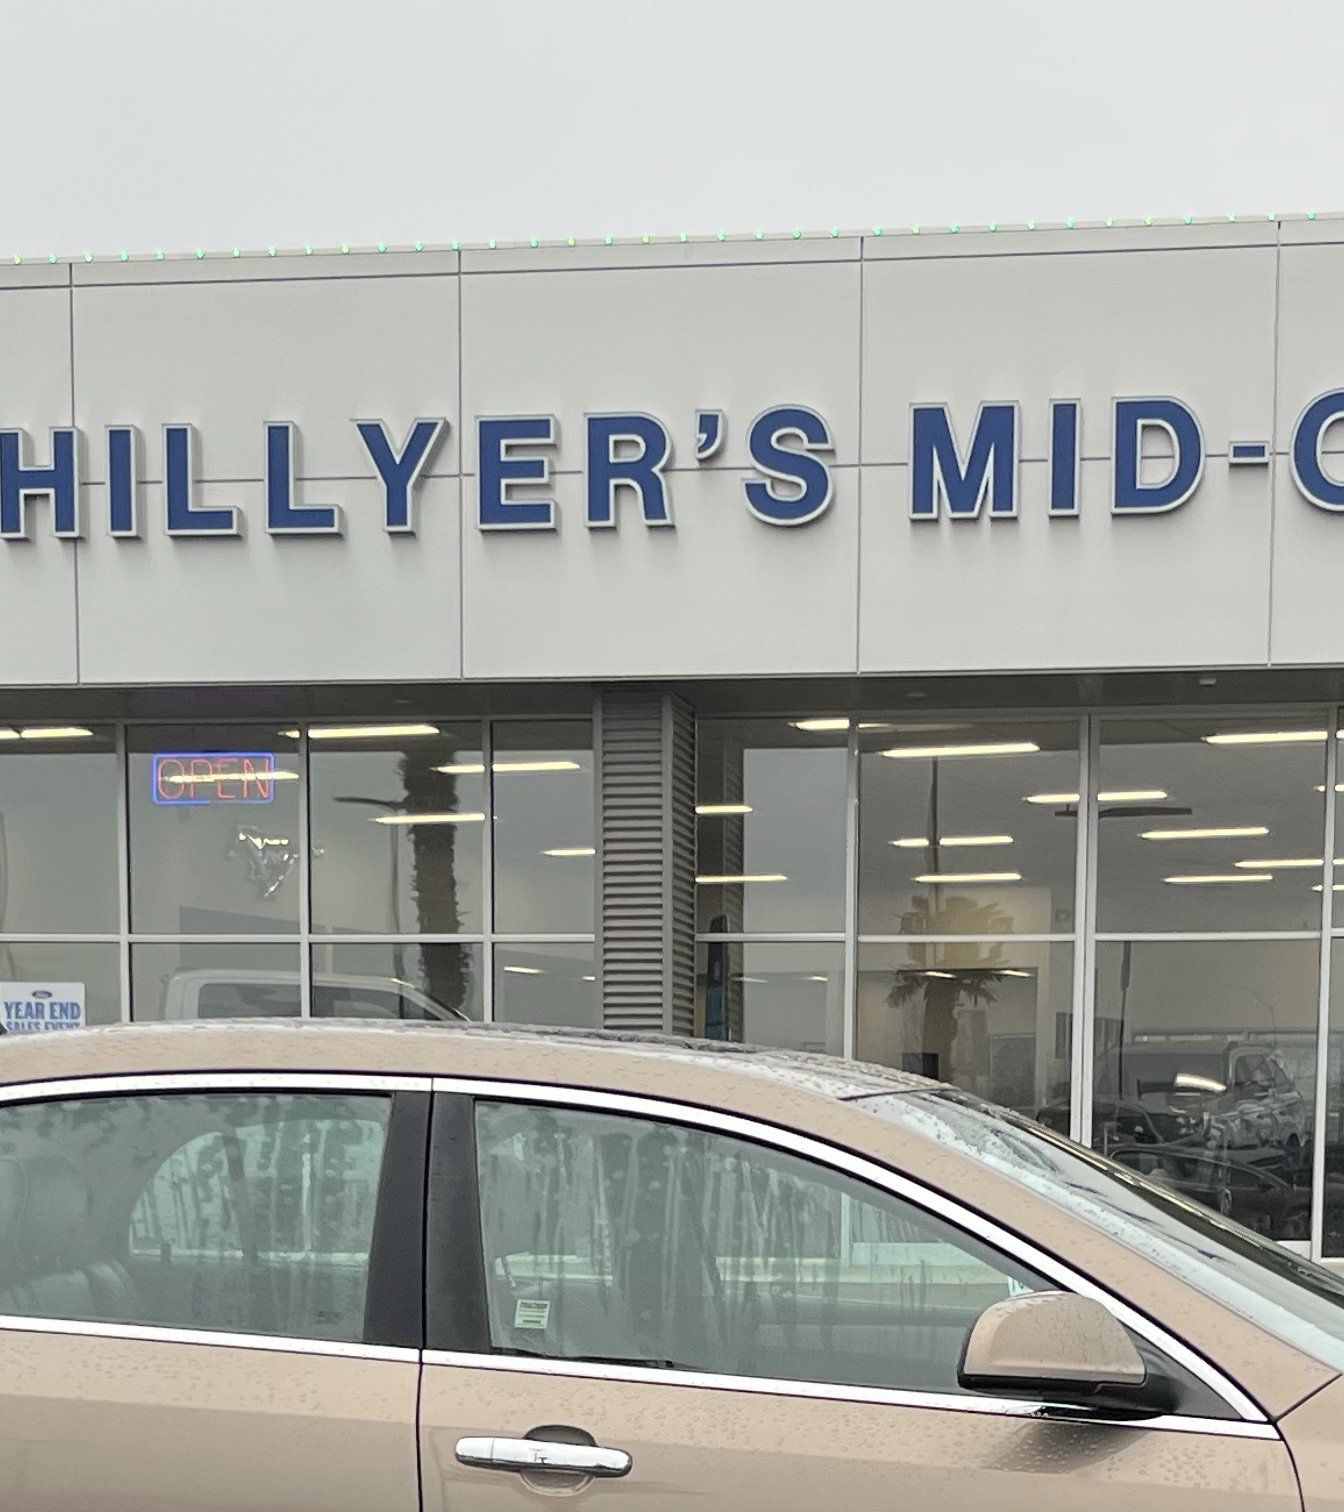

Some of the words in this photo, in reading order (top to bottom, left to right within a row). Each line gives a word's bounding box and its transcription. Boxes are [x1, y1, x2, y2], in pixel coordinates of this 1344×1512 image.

[158, 757, 269, 799] OPEN
[4, 1002, 45, 1019] YEAR
[49, 1002, 81, 1020] END
